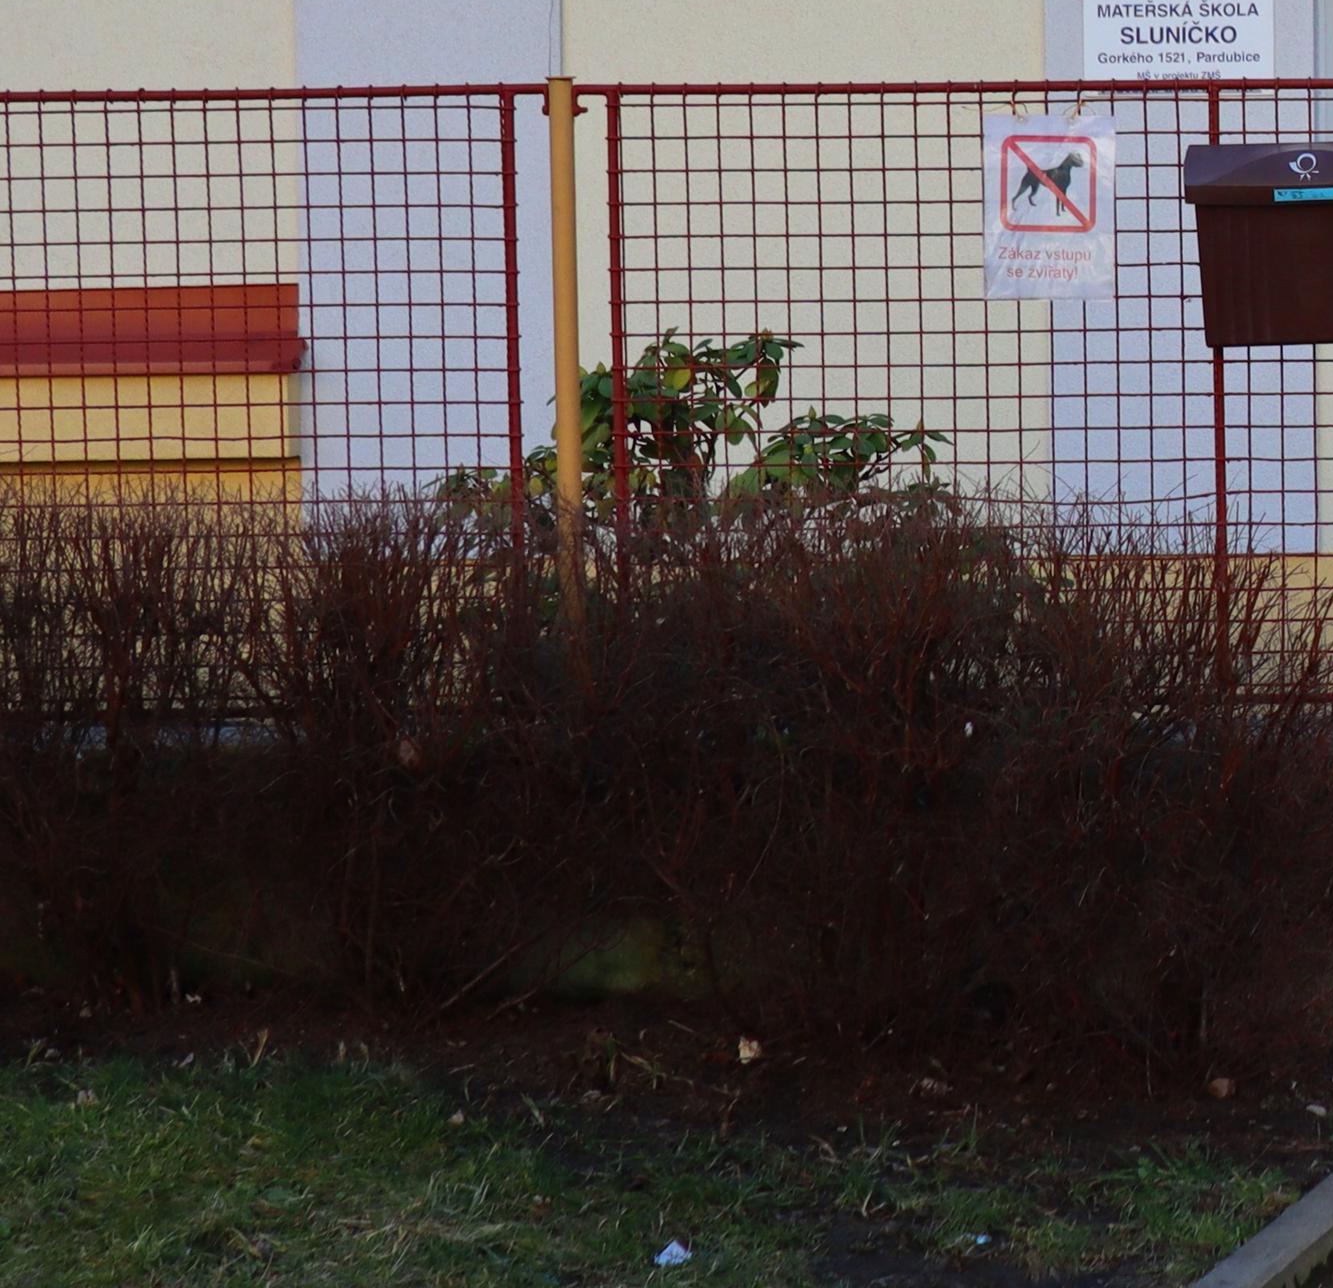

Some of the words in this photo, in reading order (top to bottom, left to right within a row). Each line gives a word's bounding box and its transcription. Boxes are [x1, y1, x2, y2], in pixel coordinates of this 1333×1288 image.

[1097, 0, 1193, 18] MATEŘSKÁ
[1199, 0, 1259, 17] ŠKOLA
[1120, 20, 1238, 45] SLUNÍČKO
[1097, 52, 1154, 64] Gorkého
[1158, 52, 1192, 65] 1521,
[1196, 51, 1261, 63] Pardubice
[998, 246, 1041, 260] Zákaz
[1045, 249, 1092, 264] vstupu
[1007, 267, 1024, 278] se
[1028, 264, 1078, 282] zvířaty!
